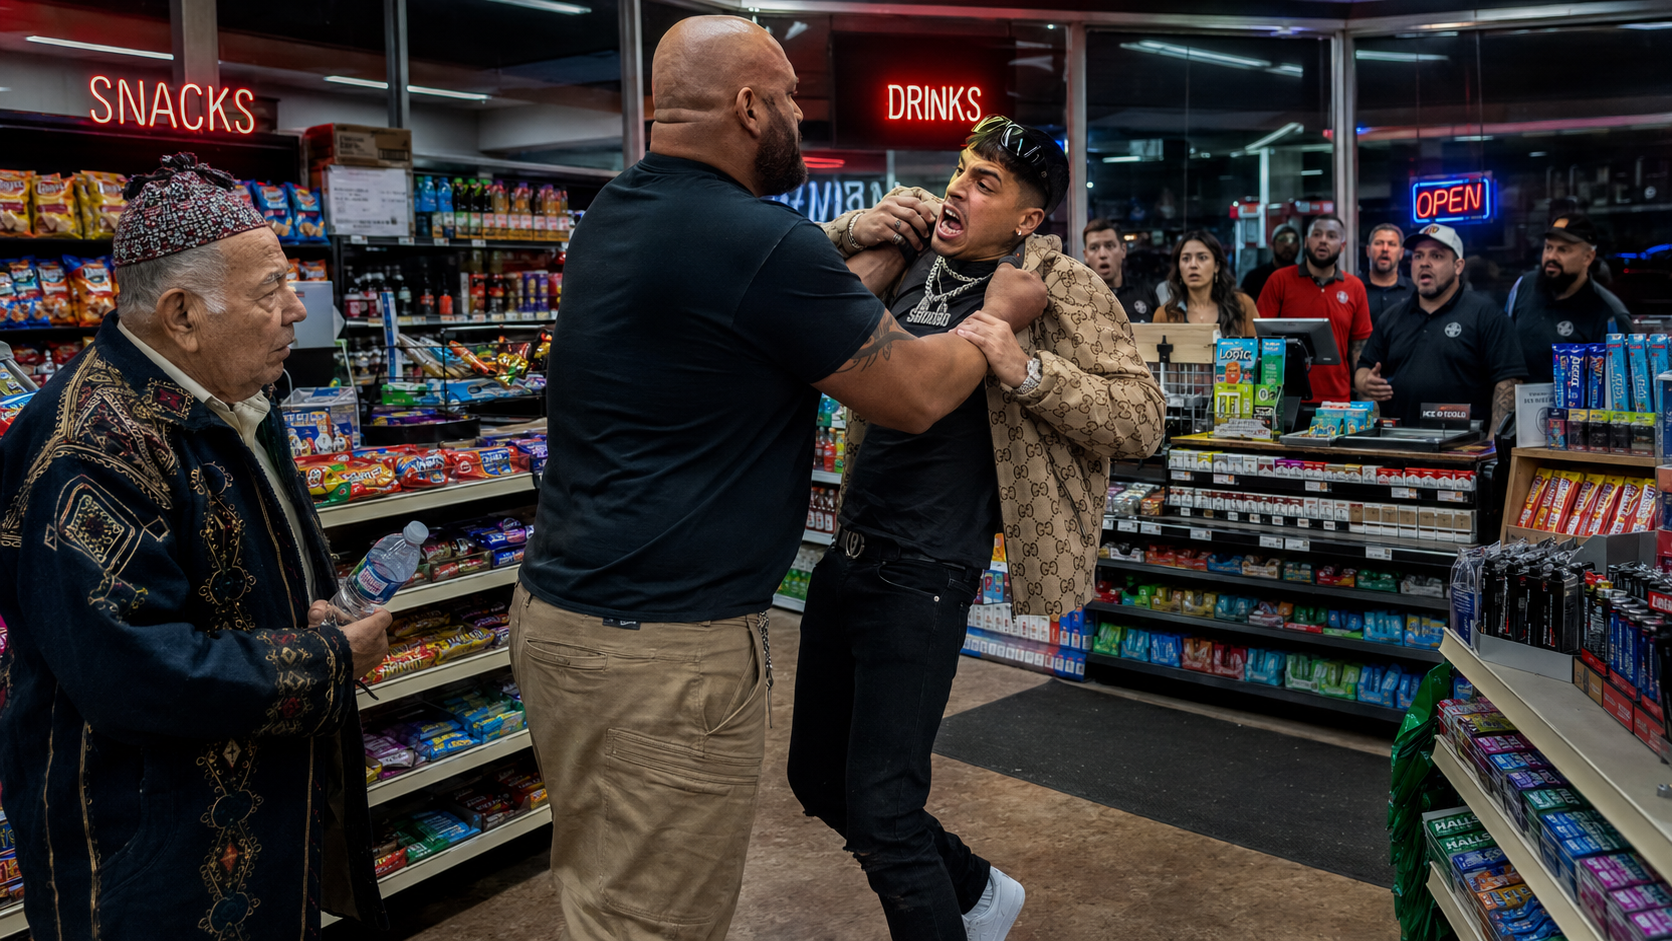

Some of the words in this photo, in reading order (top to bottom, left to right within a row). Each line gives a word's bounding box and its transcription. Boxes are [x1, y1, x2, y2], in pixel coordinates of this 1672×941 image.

[89, 75, 256, 135] SNACKS
[887, 84, 982, 122] DRINKS
[1416, 182, 1482, 218] OPEN
[1434, 815, 1479, 832] HALLS
[1446, 832, 1491, 850] HALLS
